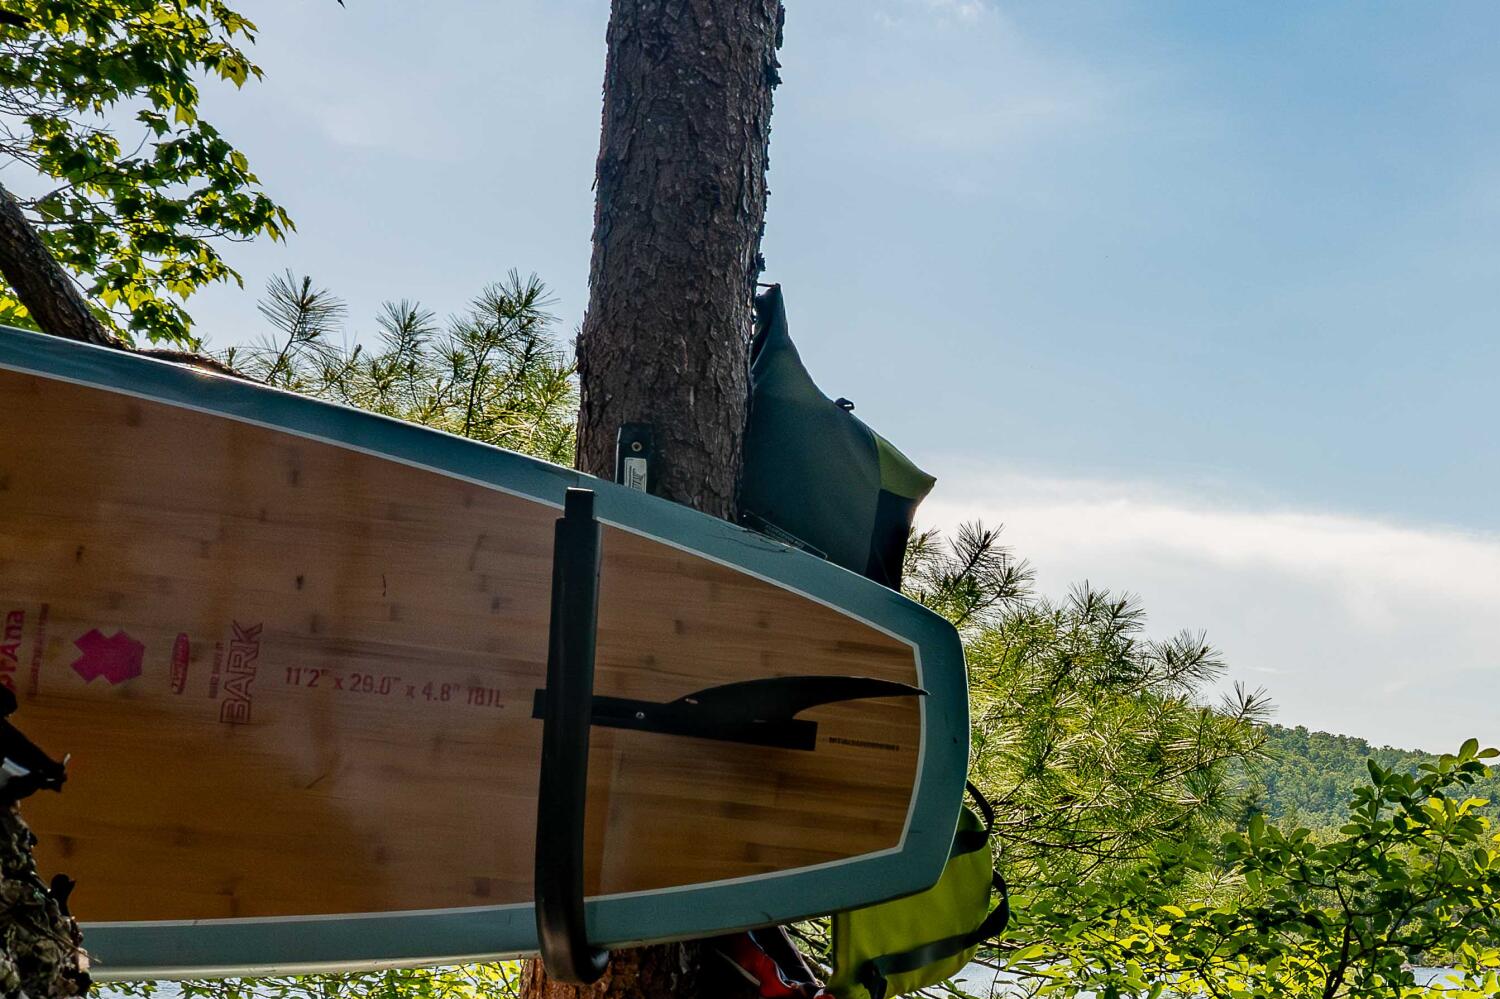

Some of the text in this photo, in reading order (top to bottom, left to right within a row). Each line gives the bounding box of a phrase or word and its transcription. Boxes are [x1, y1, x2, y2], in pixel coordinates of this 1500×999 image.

[220, 620, 263, 725] BARK
[286, 667, 329, 688] 11'2"
[334, 677, 343, 690] x
[422, 682, 461, 702] 4.8"
